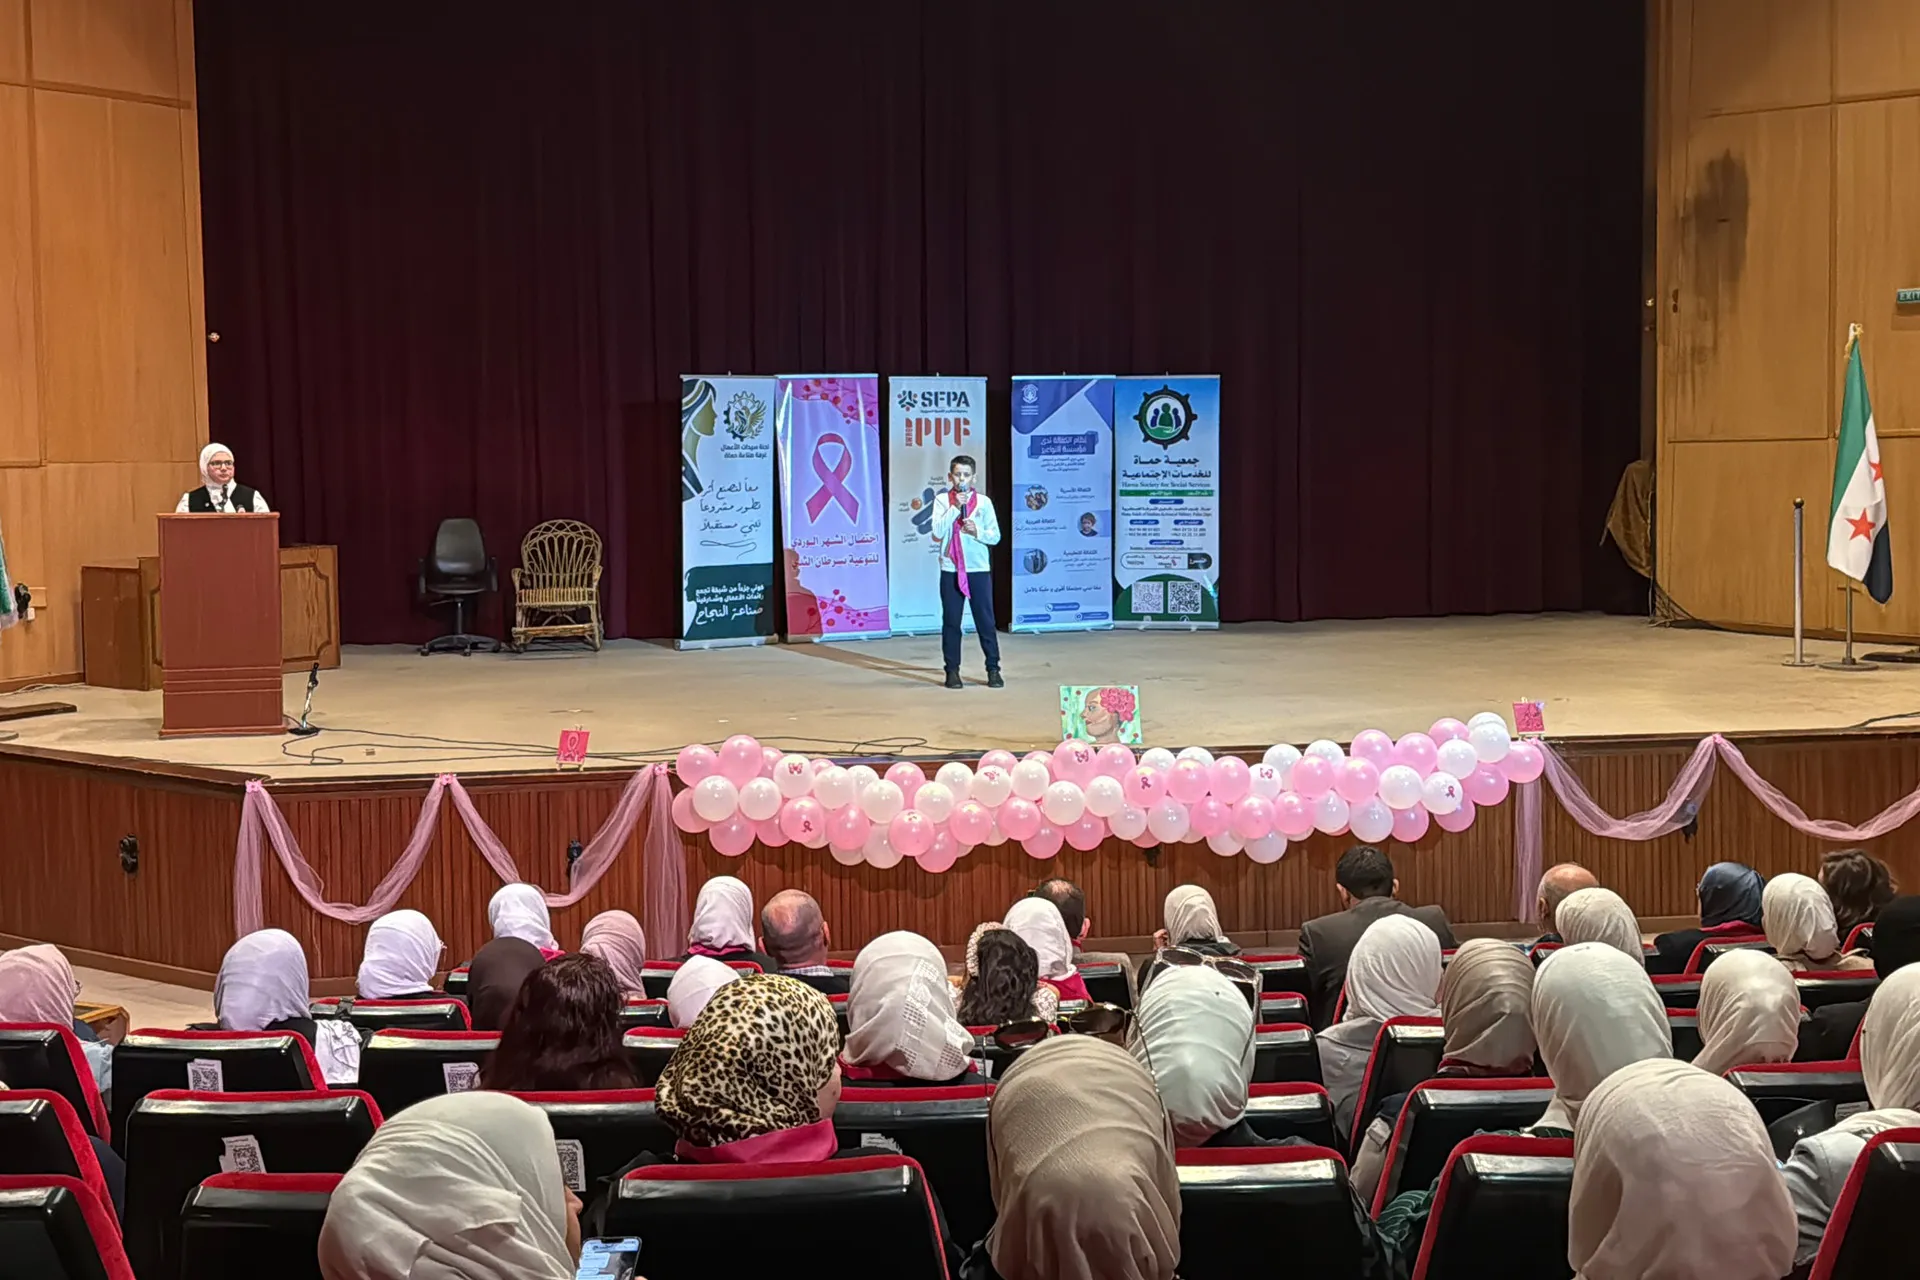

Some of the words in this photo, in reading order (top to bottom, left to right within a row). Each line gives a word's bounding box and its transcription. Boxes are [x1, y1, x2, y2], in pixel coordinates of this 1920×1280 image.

[1899, 291, 1920, 301] EXIT
[921, 391, 970, 407] SFPA
[695, 604, 728, 625] النجاح
